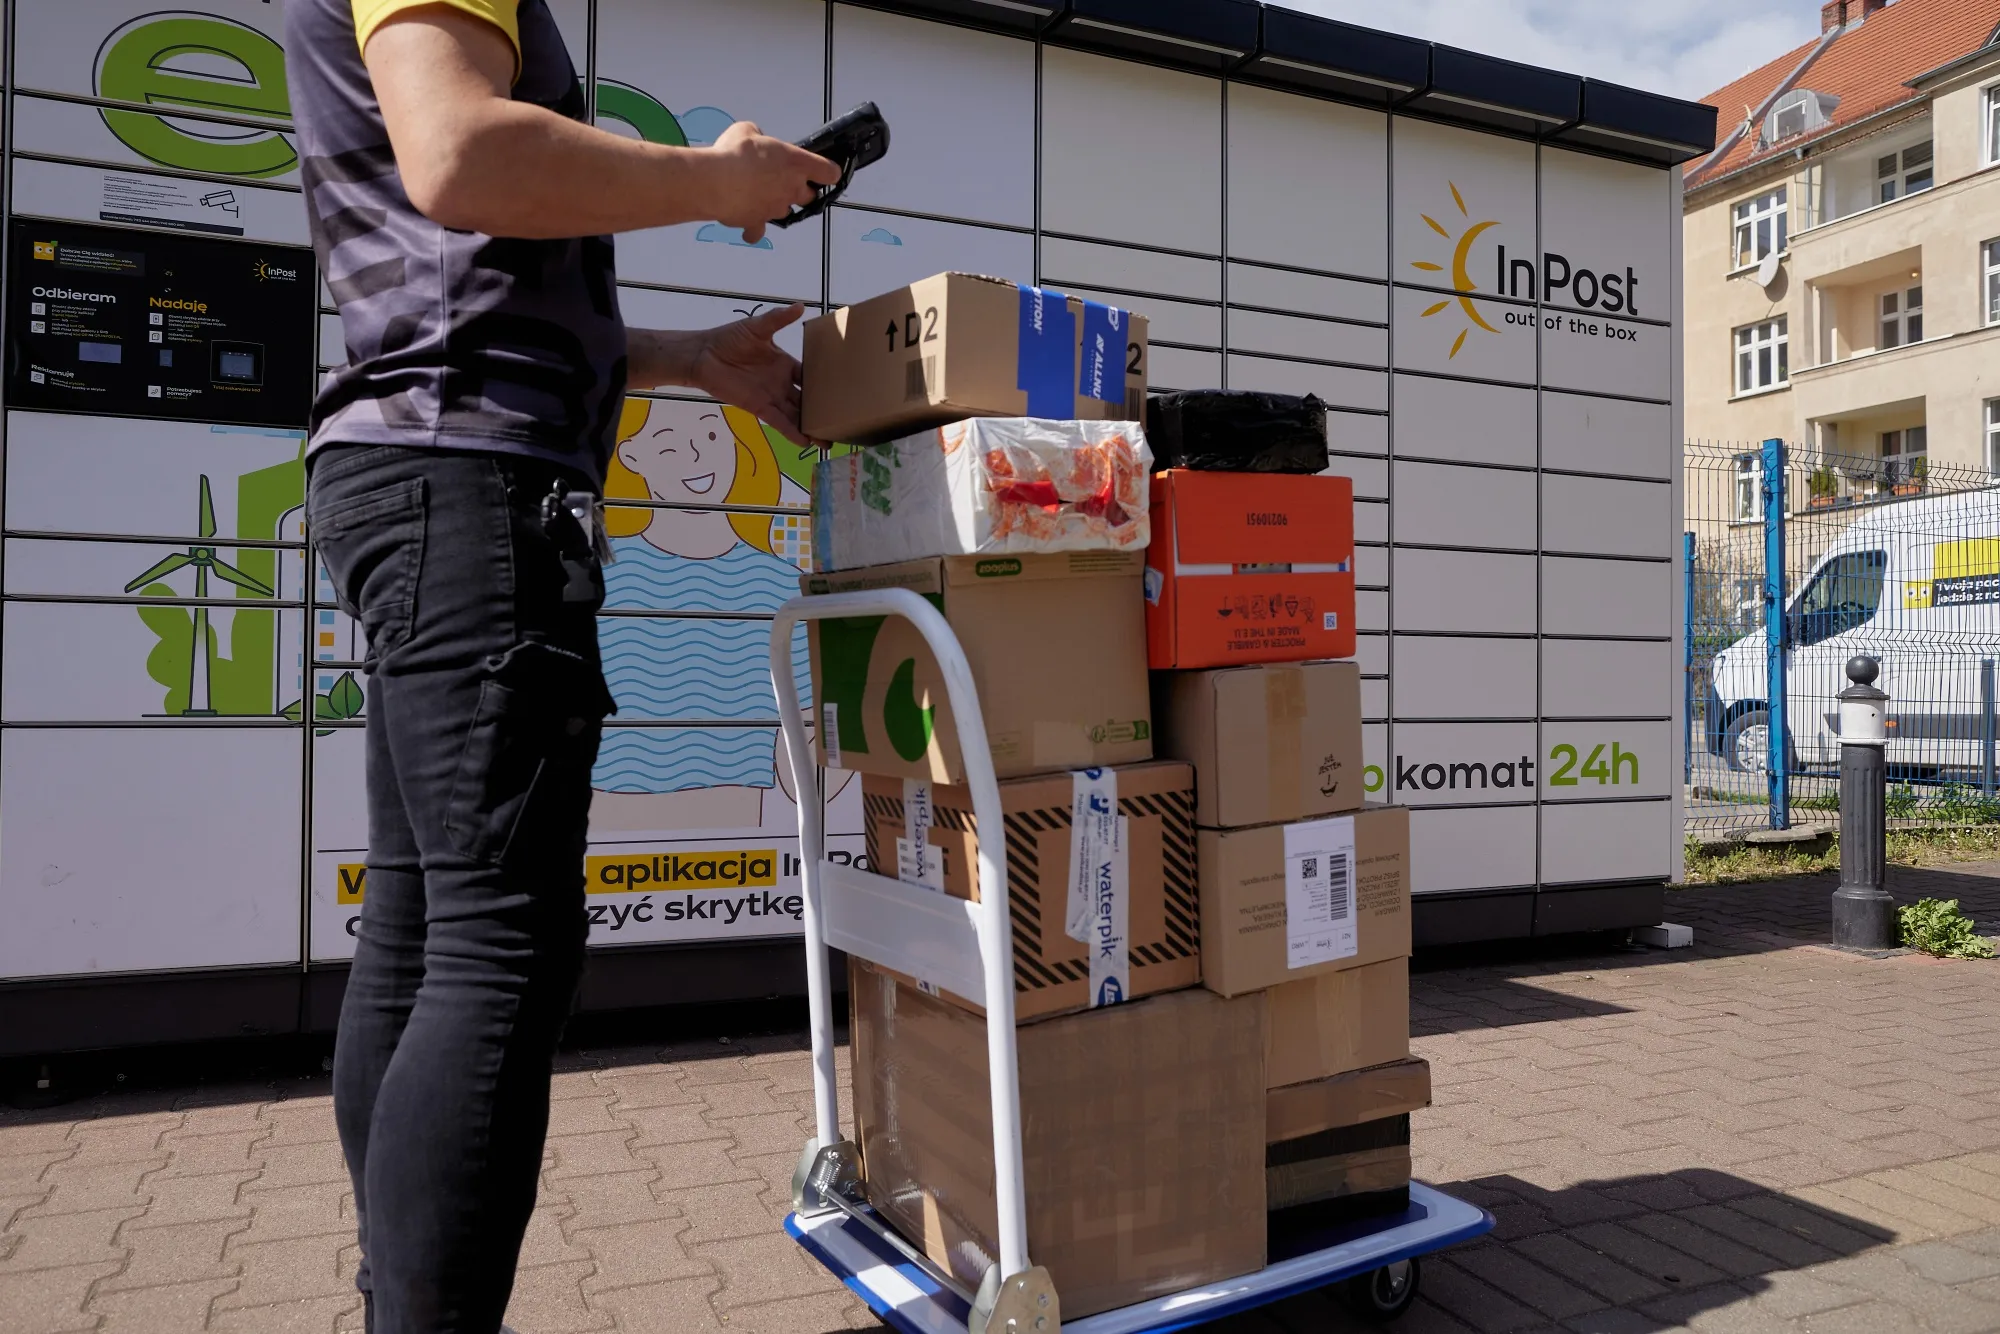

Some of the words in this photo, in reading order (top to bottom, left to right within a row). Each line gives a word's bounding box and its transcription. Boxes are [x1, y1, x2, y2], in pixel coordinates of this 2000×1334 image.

[268, 267, 297, 278] InPost
[1497, 244, 1638, 316] InPost
[32, 286, 117, 304] Odbieram
[149, 296, 208, 314] Nadaję
[904, 305, 939, 348] D2
[1504, 312, 1535, 327] out
[1544, 315, 1562, 331] of
[1569, 318, 1598, 336] the
[1605, 322, 1637, 342] box
[1092, 352, 1104, 399] ALLNU
[1126, 342, 1143, 376] 2
[1246, 512, 1288, 526] 90210951
[1549, 741, 1639, 786] 24h
[911, 787, 929, 878] waterpik
[600, 852, 771, 890] aplikacja
[664, 890, 804, 925] skrytkę
[1097, 861, 1122, 959] waterpik
